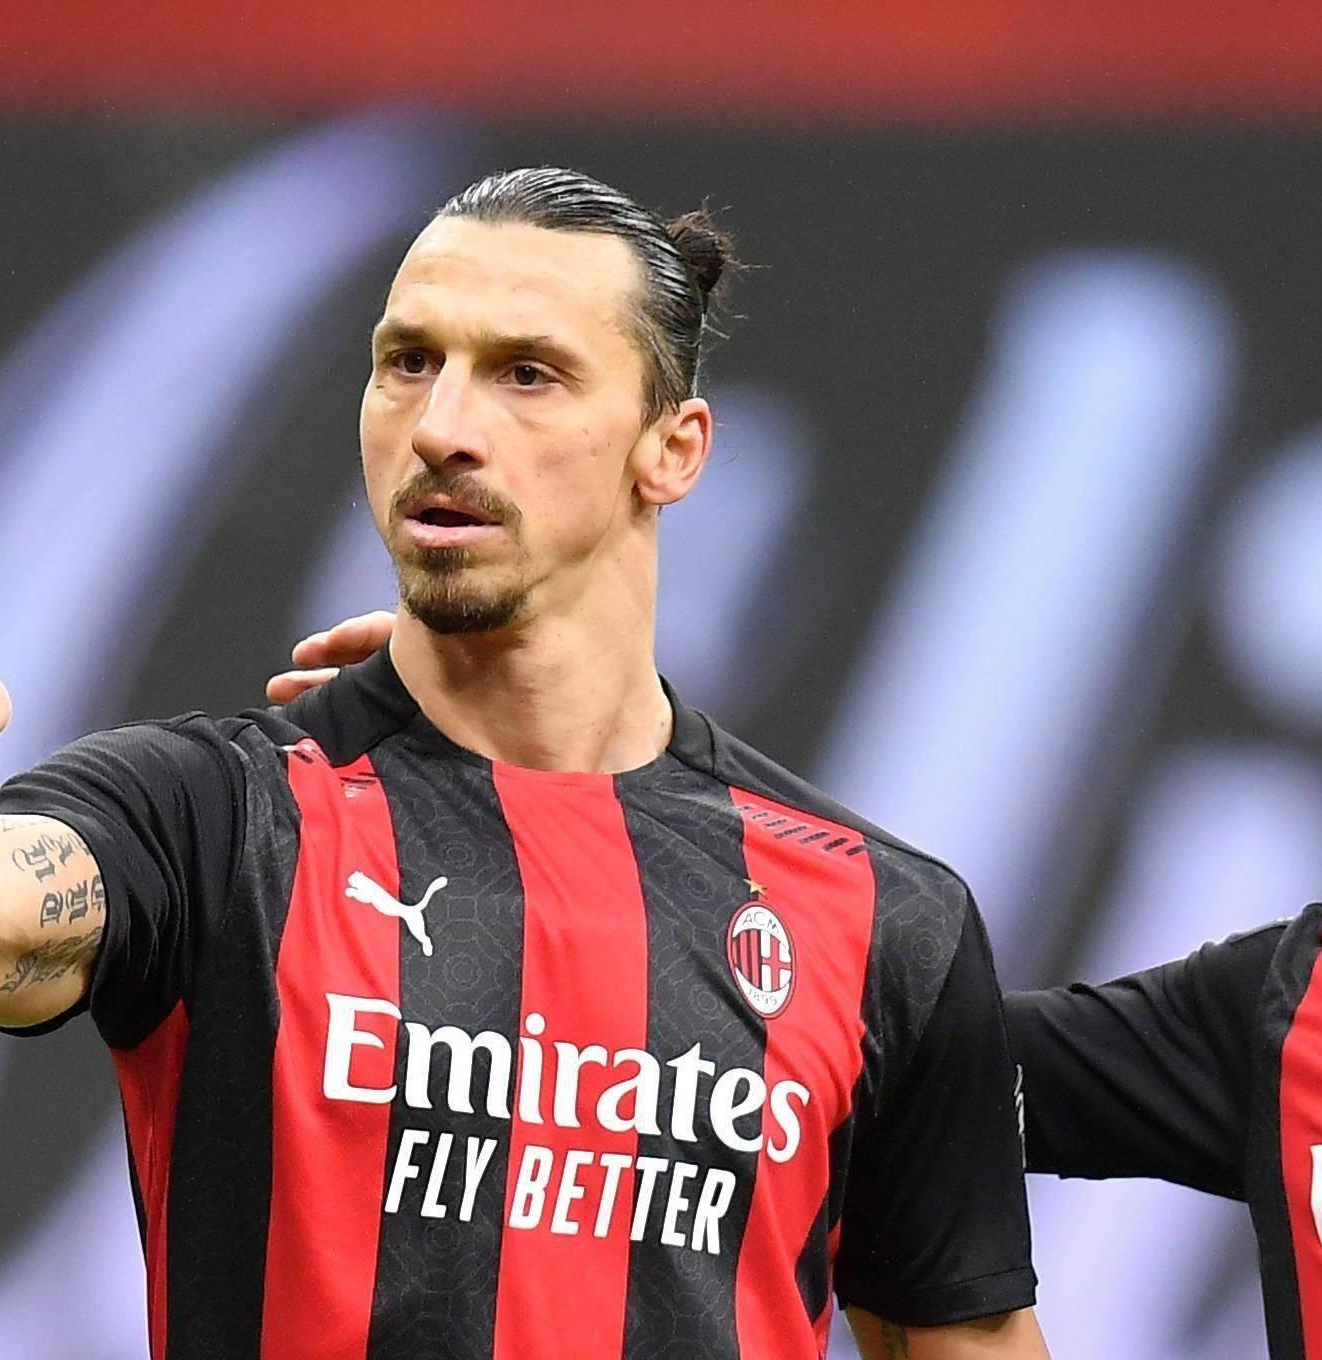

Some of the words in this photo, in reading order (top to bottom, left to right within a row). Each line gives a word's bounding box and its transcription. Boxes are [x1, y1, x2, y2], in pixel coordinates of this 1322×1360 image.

[741, 910, 780, 936] ACM
[322, 992, 811, 1164] Emirates
[383, 1129, 499, 1223] FLY
[507, 1145, 737, 1256] BETTER
